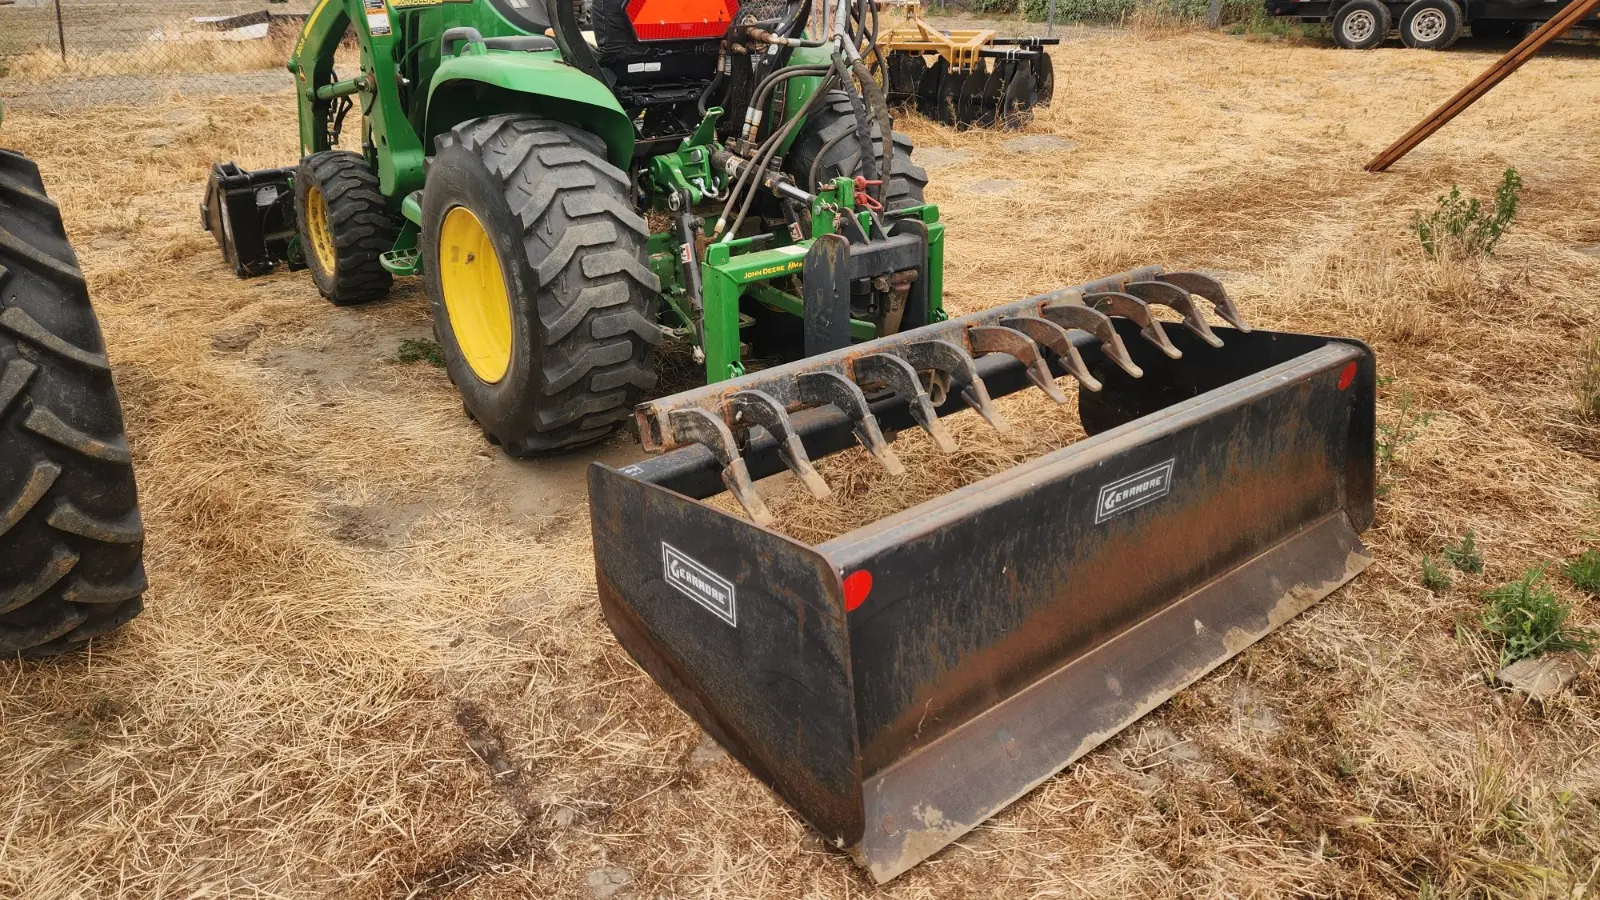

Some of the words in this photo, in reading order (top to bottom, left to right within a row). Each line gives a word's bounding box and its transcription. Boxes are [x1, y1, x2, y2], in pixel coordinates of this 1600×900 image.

[744, 270, 762, 279] JOHN
[763, 265, 785, 275] DEERE
[1104, 476, 1162, 510] GEARMORE
[670, 560, 726, 605] GEARMORE
